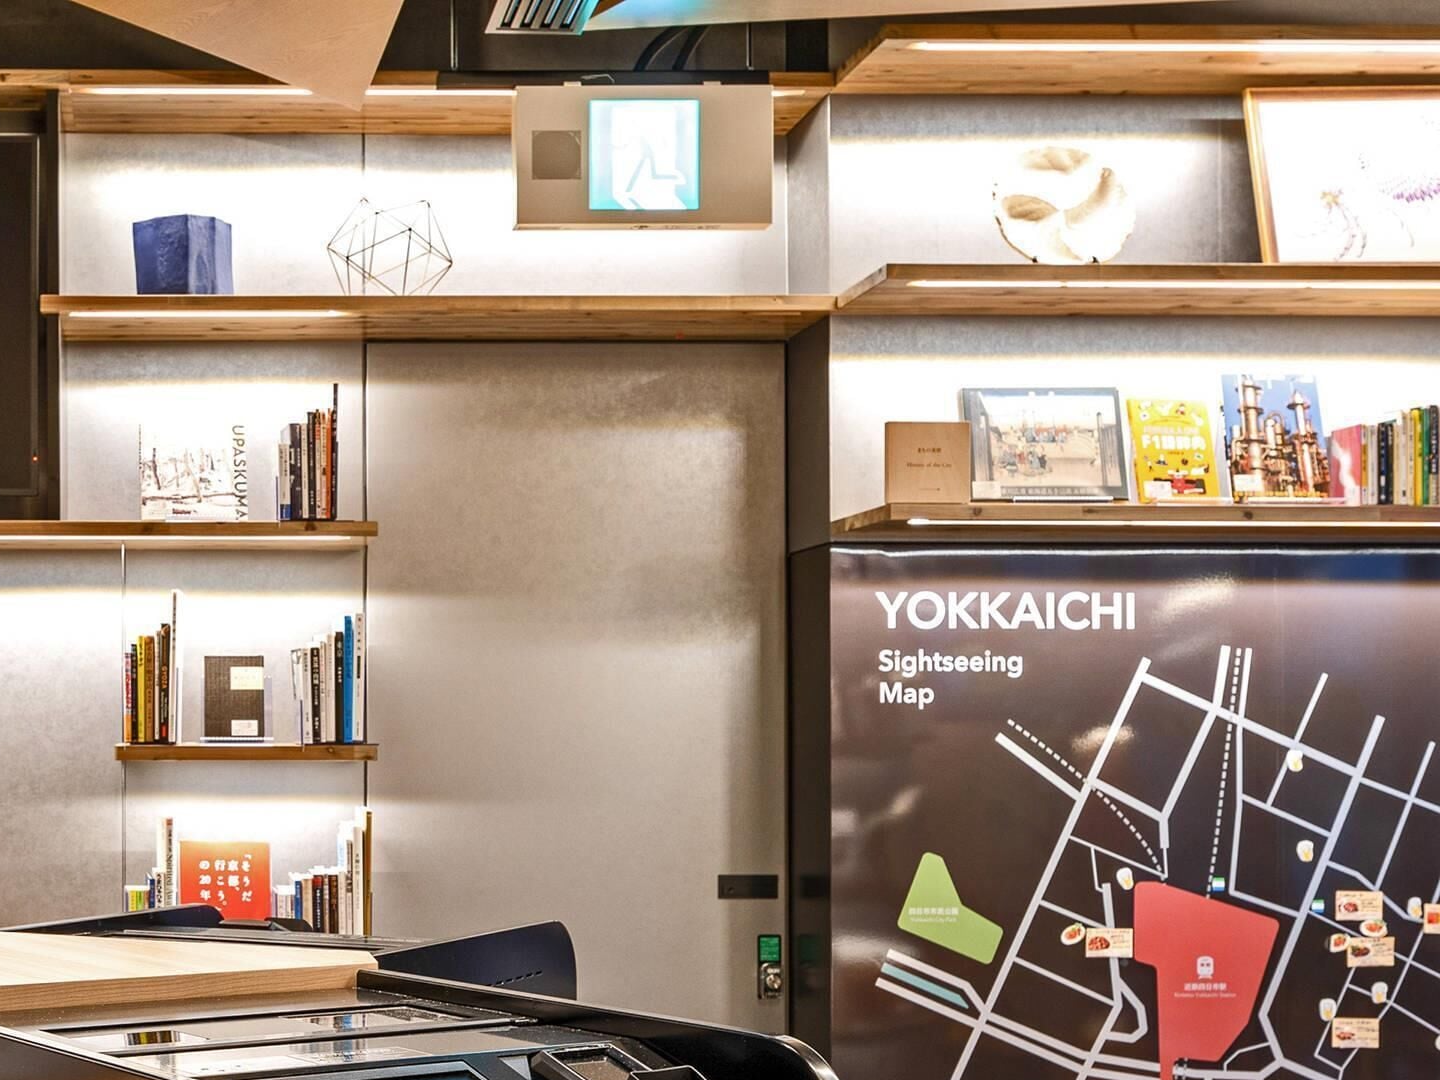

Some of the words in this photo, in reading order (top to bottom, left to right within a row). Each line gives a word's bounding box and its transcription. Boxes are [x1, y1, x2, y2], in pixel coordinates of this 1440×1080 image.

[231, 424, 249, 520] UPASKUMA
[875, 591, 1136, 631] YOKKAICHI
[878, 648, 1023, 678] Sightseeing
[879, 681, 935, 710] Map
